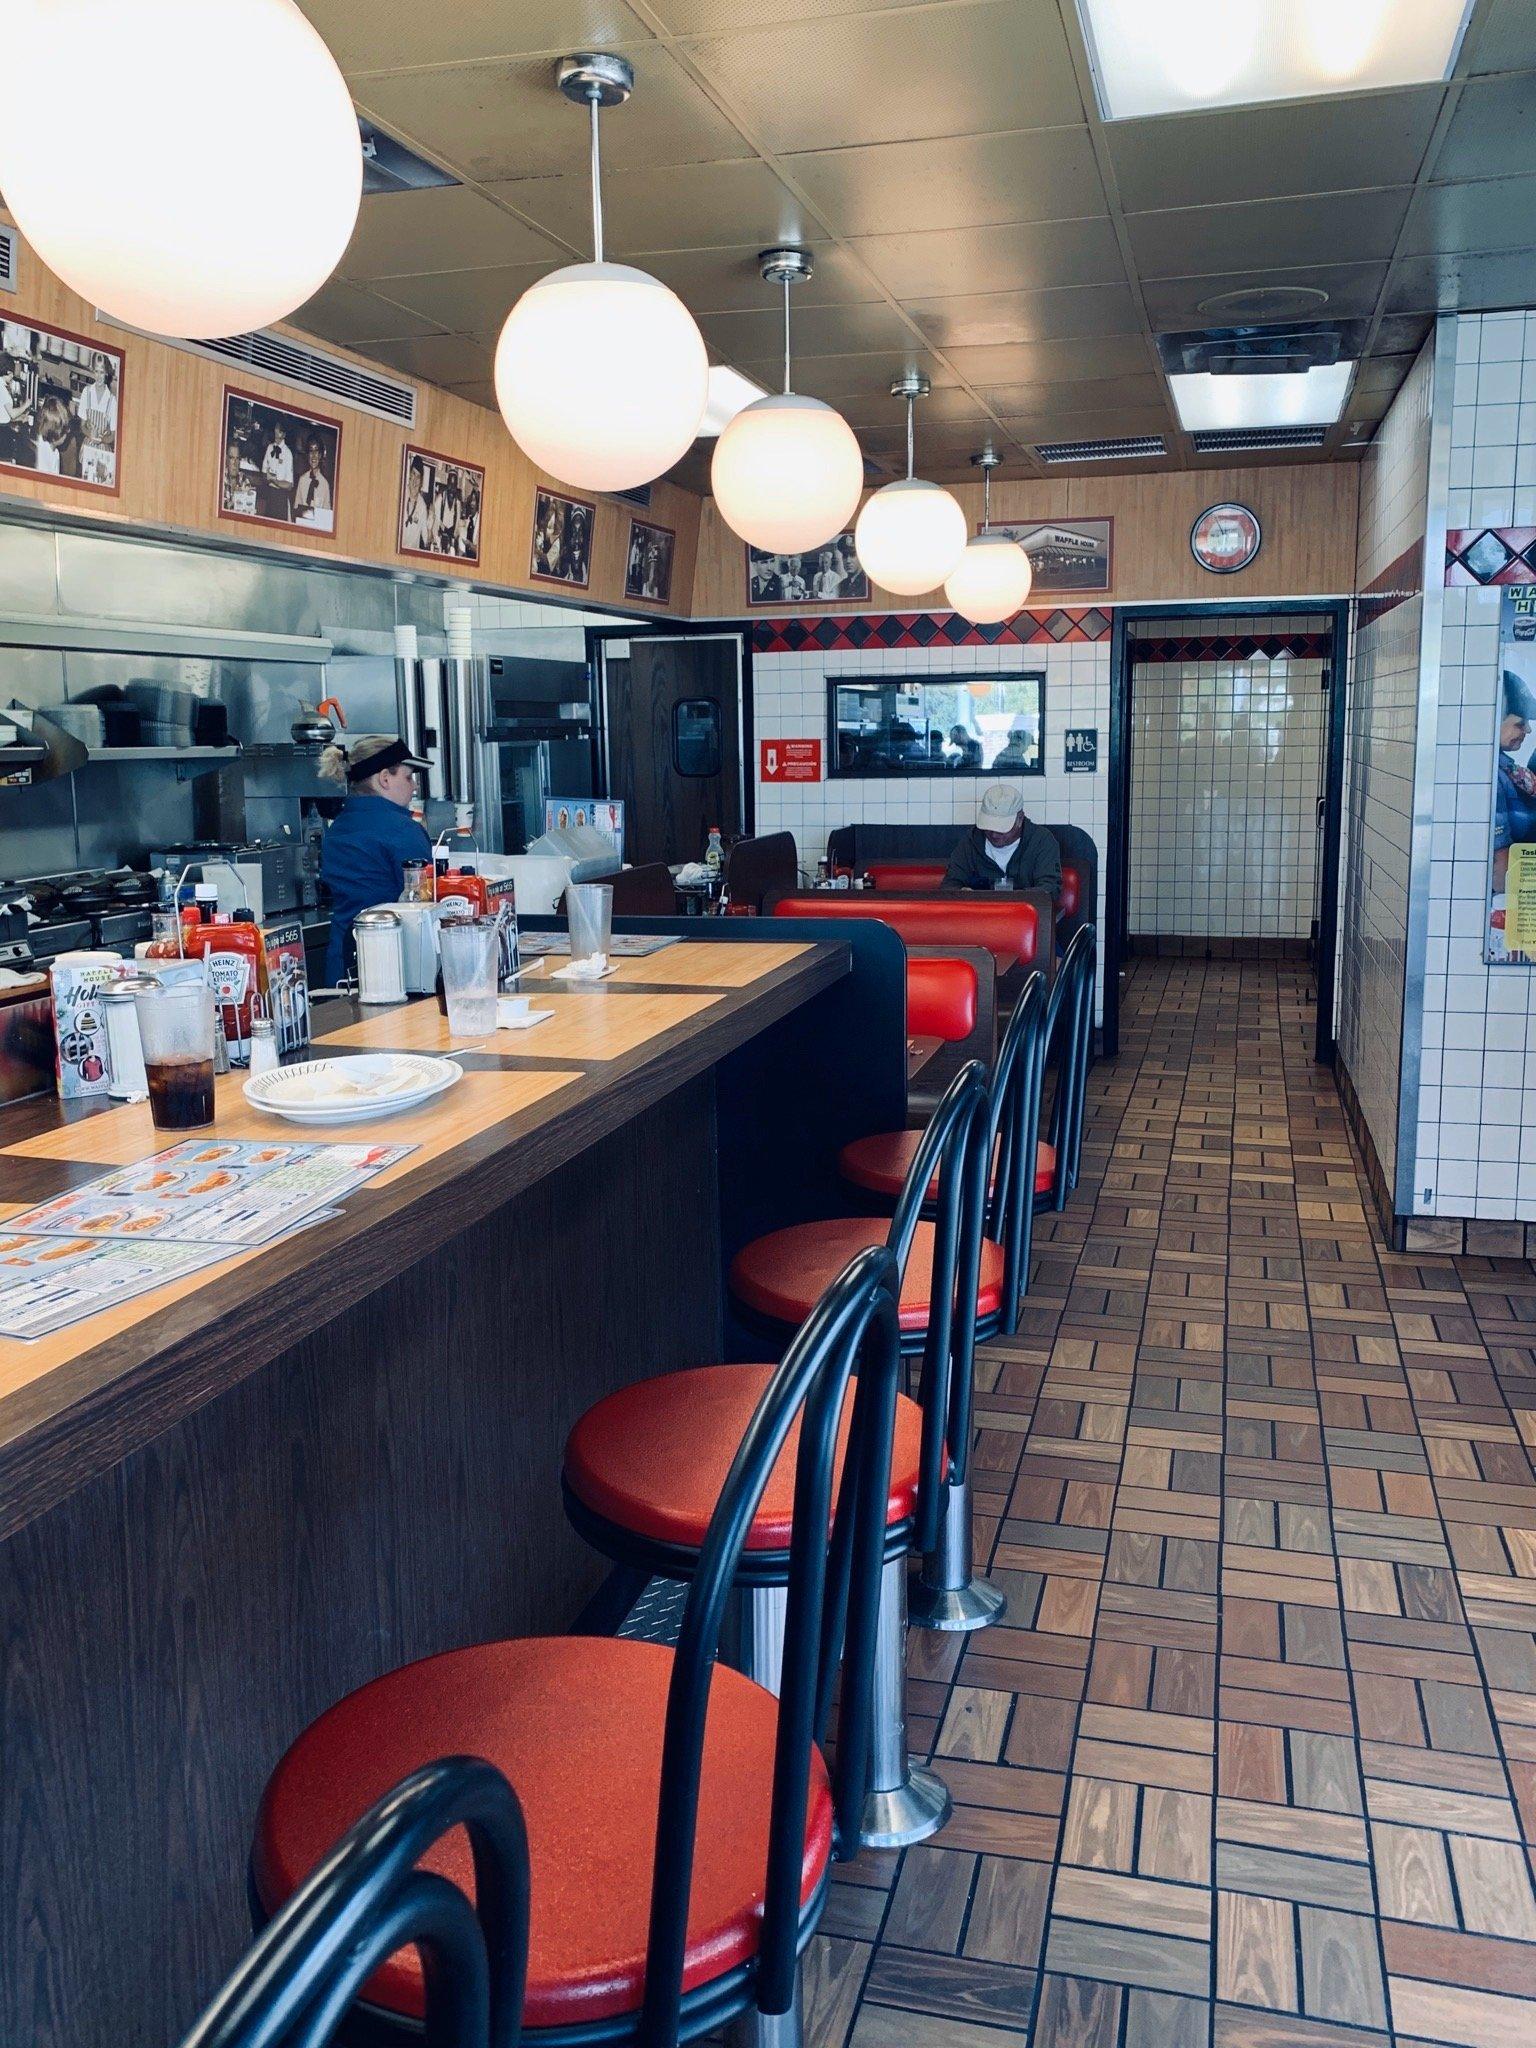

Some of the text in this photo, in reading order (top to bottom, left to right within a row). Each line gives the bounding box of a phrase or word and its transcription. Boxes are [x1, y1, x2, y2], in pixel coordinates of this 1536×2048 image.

[1055, 535, 1079, 546] WAFFLE
[285, 929, 299, 943] 565
[212, 959, 236, 967] HEINZ
